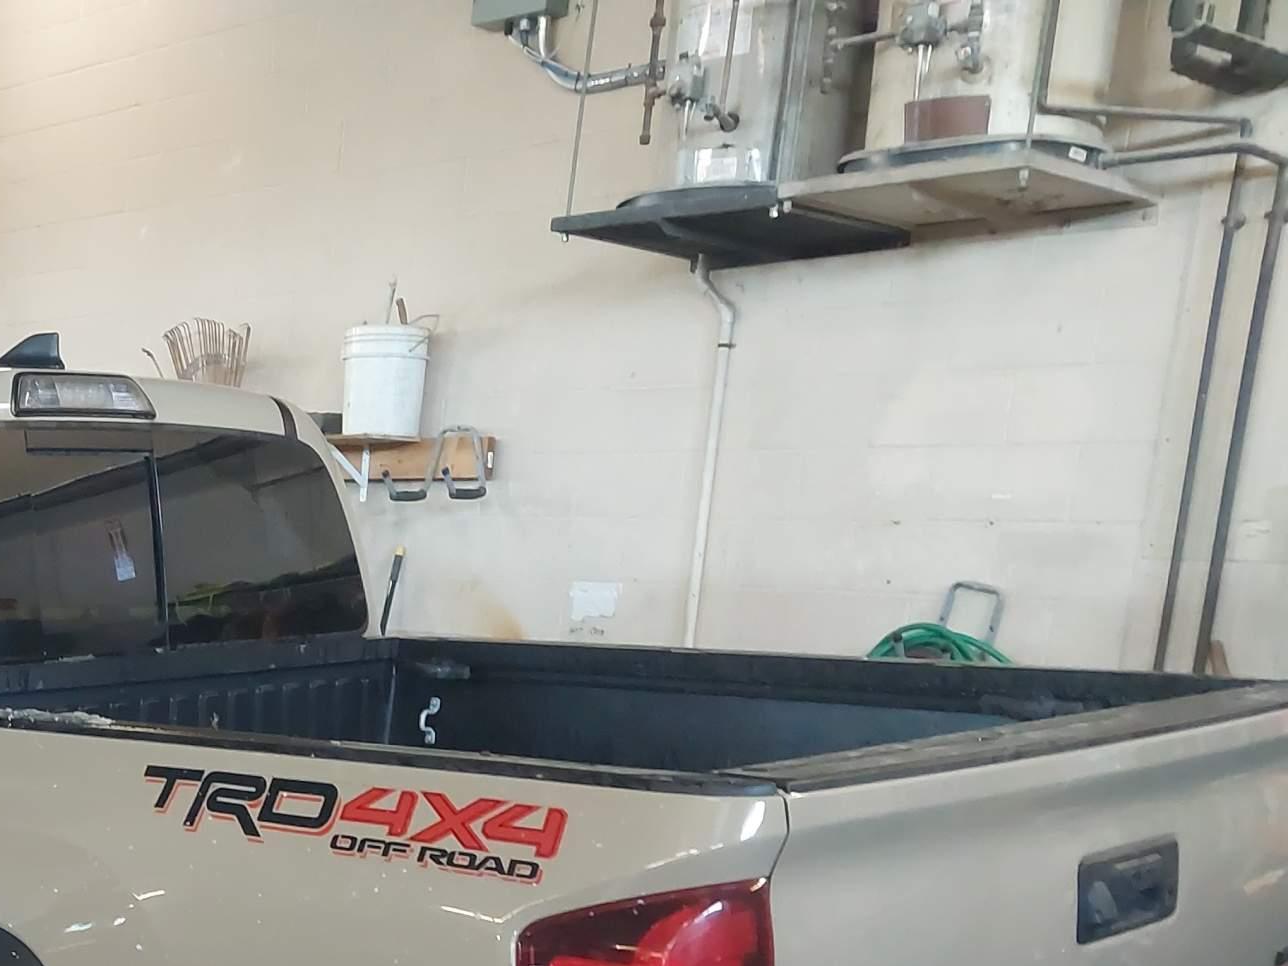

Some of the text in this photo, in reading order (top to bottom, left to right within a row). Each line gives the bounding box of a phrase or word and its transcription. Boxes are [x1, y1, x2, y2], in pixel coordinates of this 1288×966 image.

[144, 765, 569, 860] TRD 4X4
[329, 834, 544, 886] OFF ROAD
